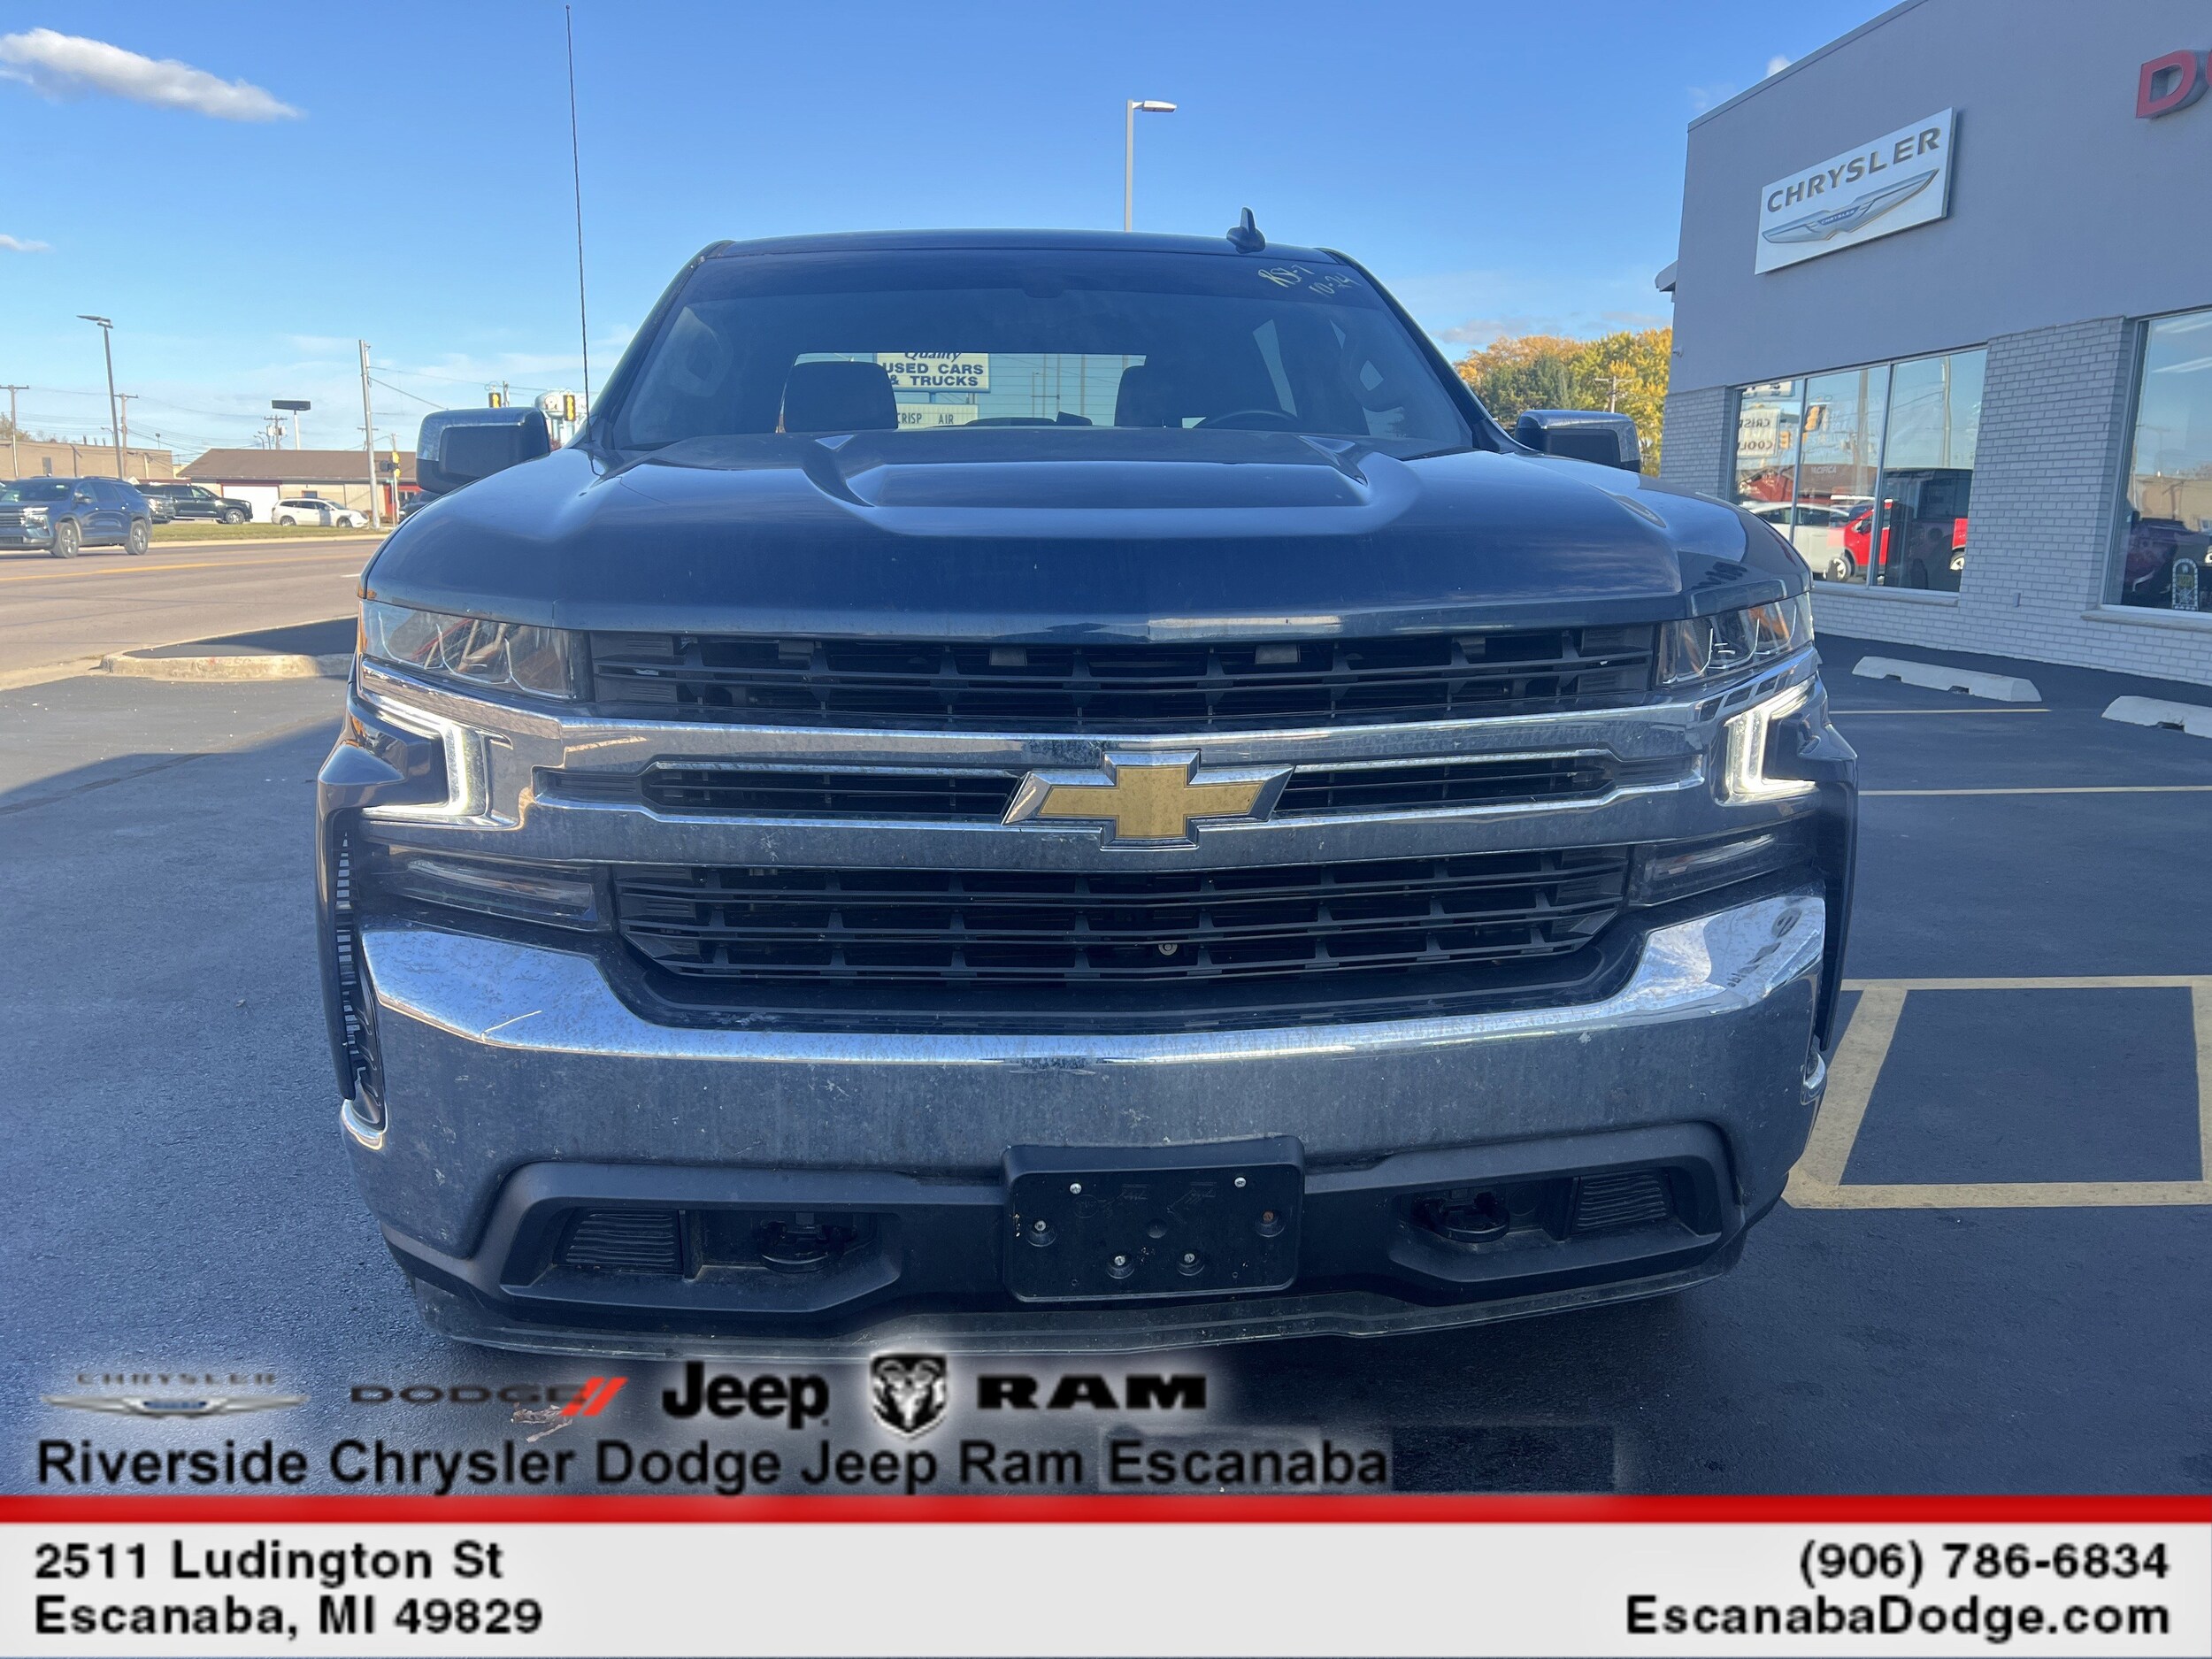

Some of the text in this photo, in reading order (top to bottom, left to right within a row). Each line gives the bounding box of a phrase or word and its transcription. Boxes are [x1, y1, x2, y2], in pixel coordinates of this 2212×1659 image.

[2136, 49, 2212, 119] D
[1768, 127, 1941, 212] CHRYSLER
[883, 363, 984, 374] USED CARS
[910, 375, 979, 386] TRUCKS
[938, 414, 954, 425] AIR
